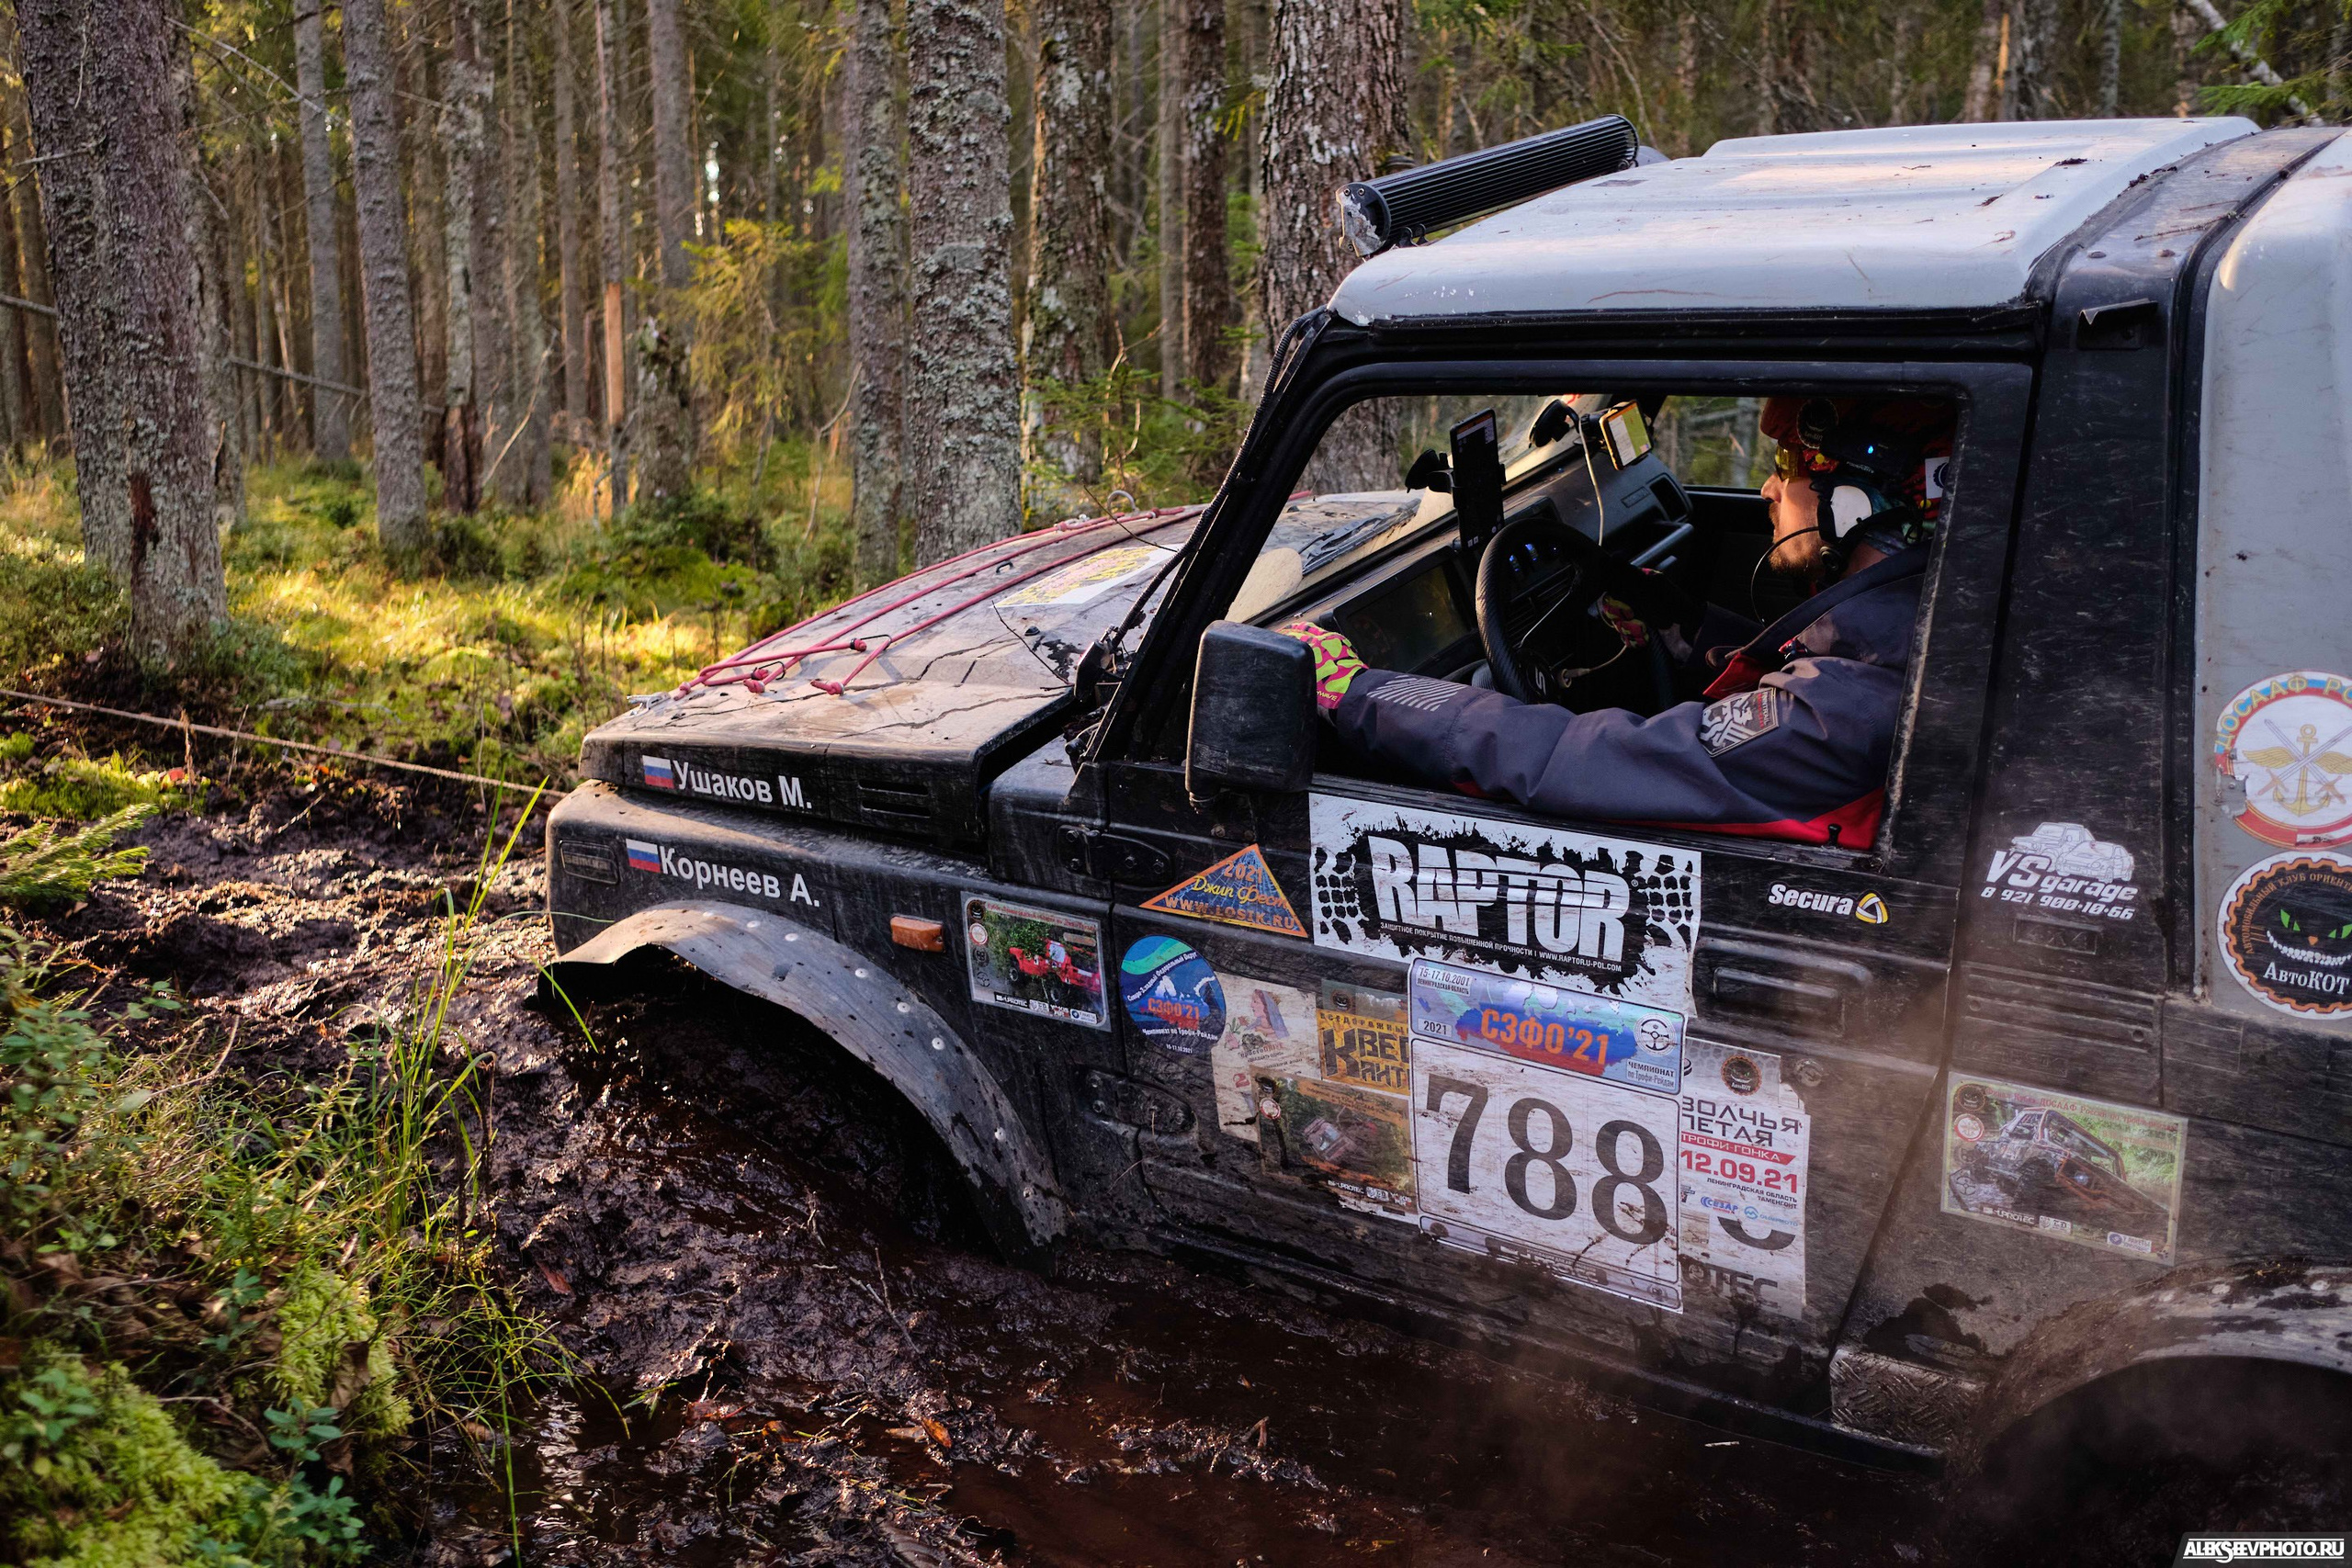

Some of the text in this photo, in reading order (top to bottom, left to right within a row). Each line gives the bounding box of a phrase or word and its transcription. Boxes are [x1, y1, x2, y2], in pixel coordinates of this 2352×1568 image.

[2215, 675, 2308, 751] ДОСААФ
[673, 760, 812, 809] Ушаков М.
[660, 845, 820, 908] Корнеев А.
[1224, 861, 1262, 884] 2021
[1985, 850, 2139, 904] VS garage
[1192, 875, 1288, 909] Джип Фест
[1369, 835, 1630, 963] RAPTOR
[1768, 883, 1854, 916] Secura
[1981, 886, 1996, 898] 8
[2001, 888, 2034, 904] 921
[1164, 896, 1295, 931] WWW.LOSIK.RU
[2242, 881, 2278, 954] АВТОМОБИЛЬНЫЙ
[2278, 873, 2306, 888] КЛУБ
[1380, 921, 1532, 957] ЗАЩИТНОЕ ПОКРЫТИЕ ПОВЫШЕННОЙ ПРОЧНОСТИ
[1417, 977, 1451, 991] ЛЕНИНГРАДСКАЯ
[1320, 1012, 1408, 1034] ВСЕДОРОЖНЫ
[1423, 1019, 1448, 1035] 2021
[1628, 1061, 1674, 1077] ЧЕМПИОНАТ
[1682, 1096, 1800, 1135] ВОЛЧЬЯ
[2041, 1097, 2076, 1112] ДОСААФ
[1427, 1073, 1668, 1245] 788
[1681, 1133, 1781, 1163] ТРОФИ-ГОНКА
[1680, 1149, 1798, 1194] 12.09.21
[1707, 1178, 1765, 1196] ЛЕНИНГРАДСКАЯ
[1766, 1191, 1798, 1203] ОБЛАСТЬ
[1758, 1195, 1798, 1210] ТАМЕНГОНТ
